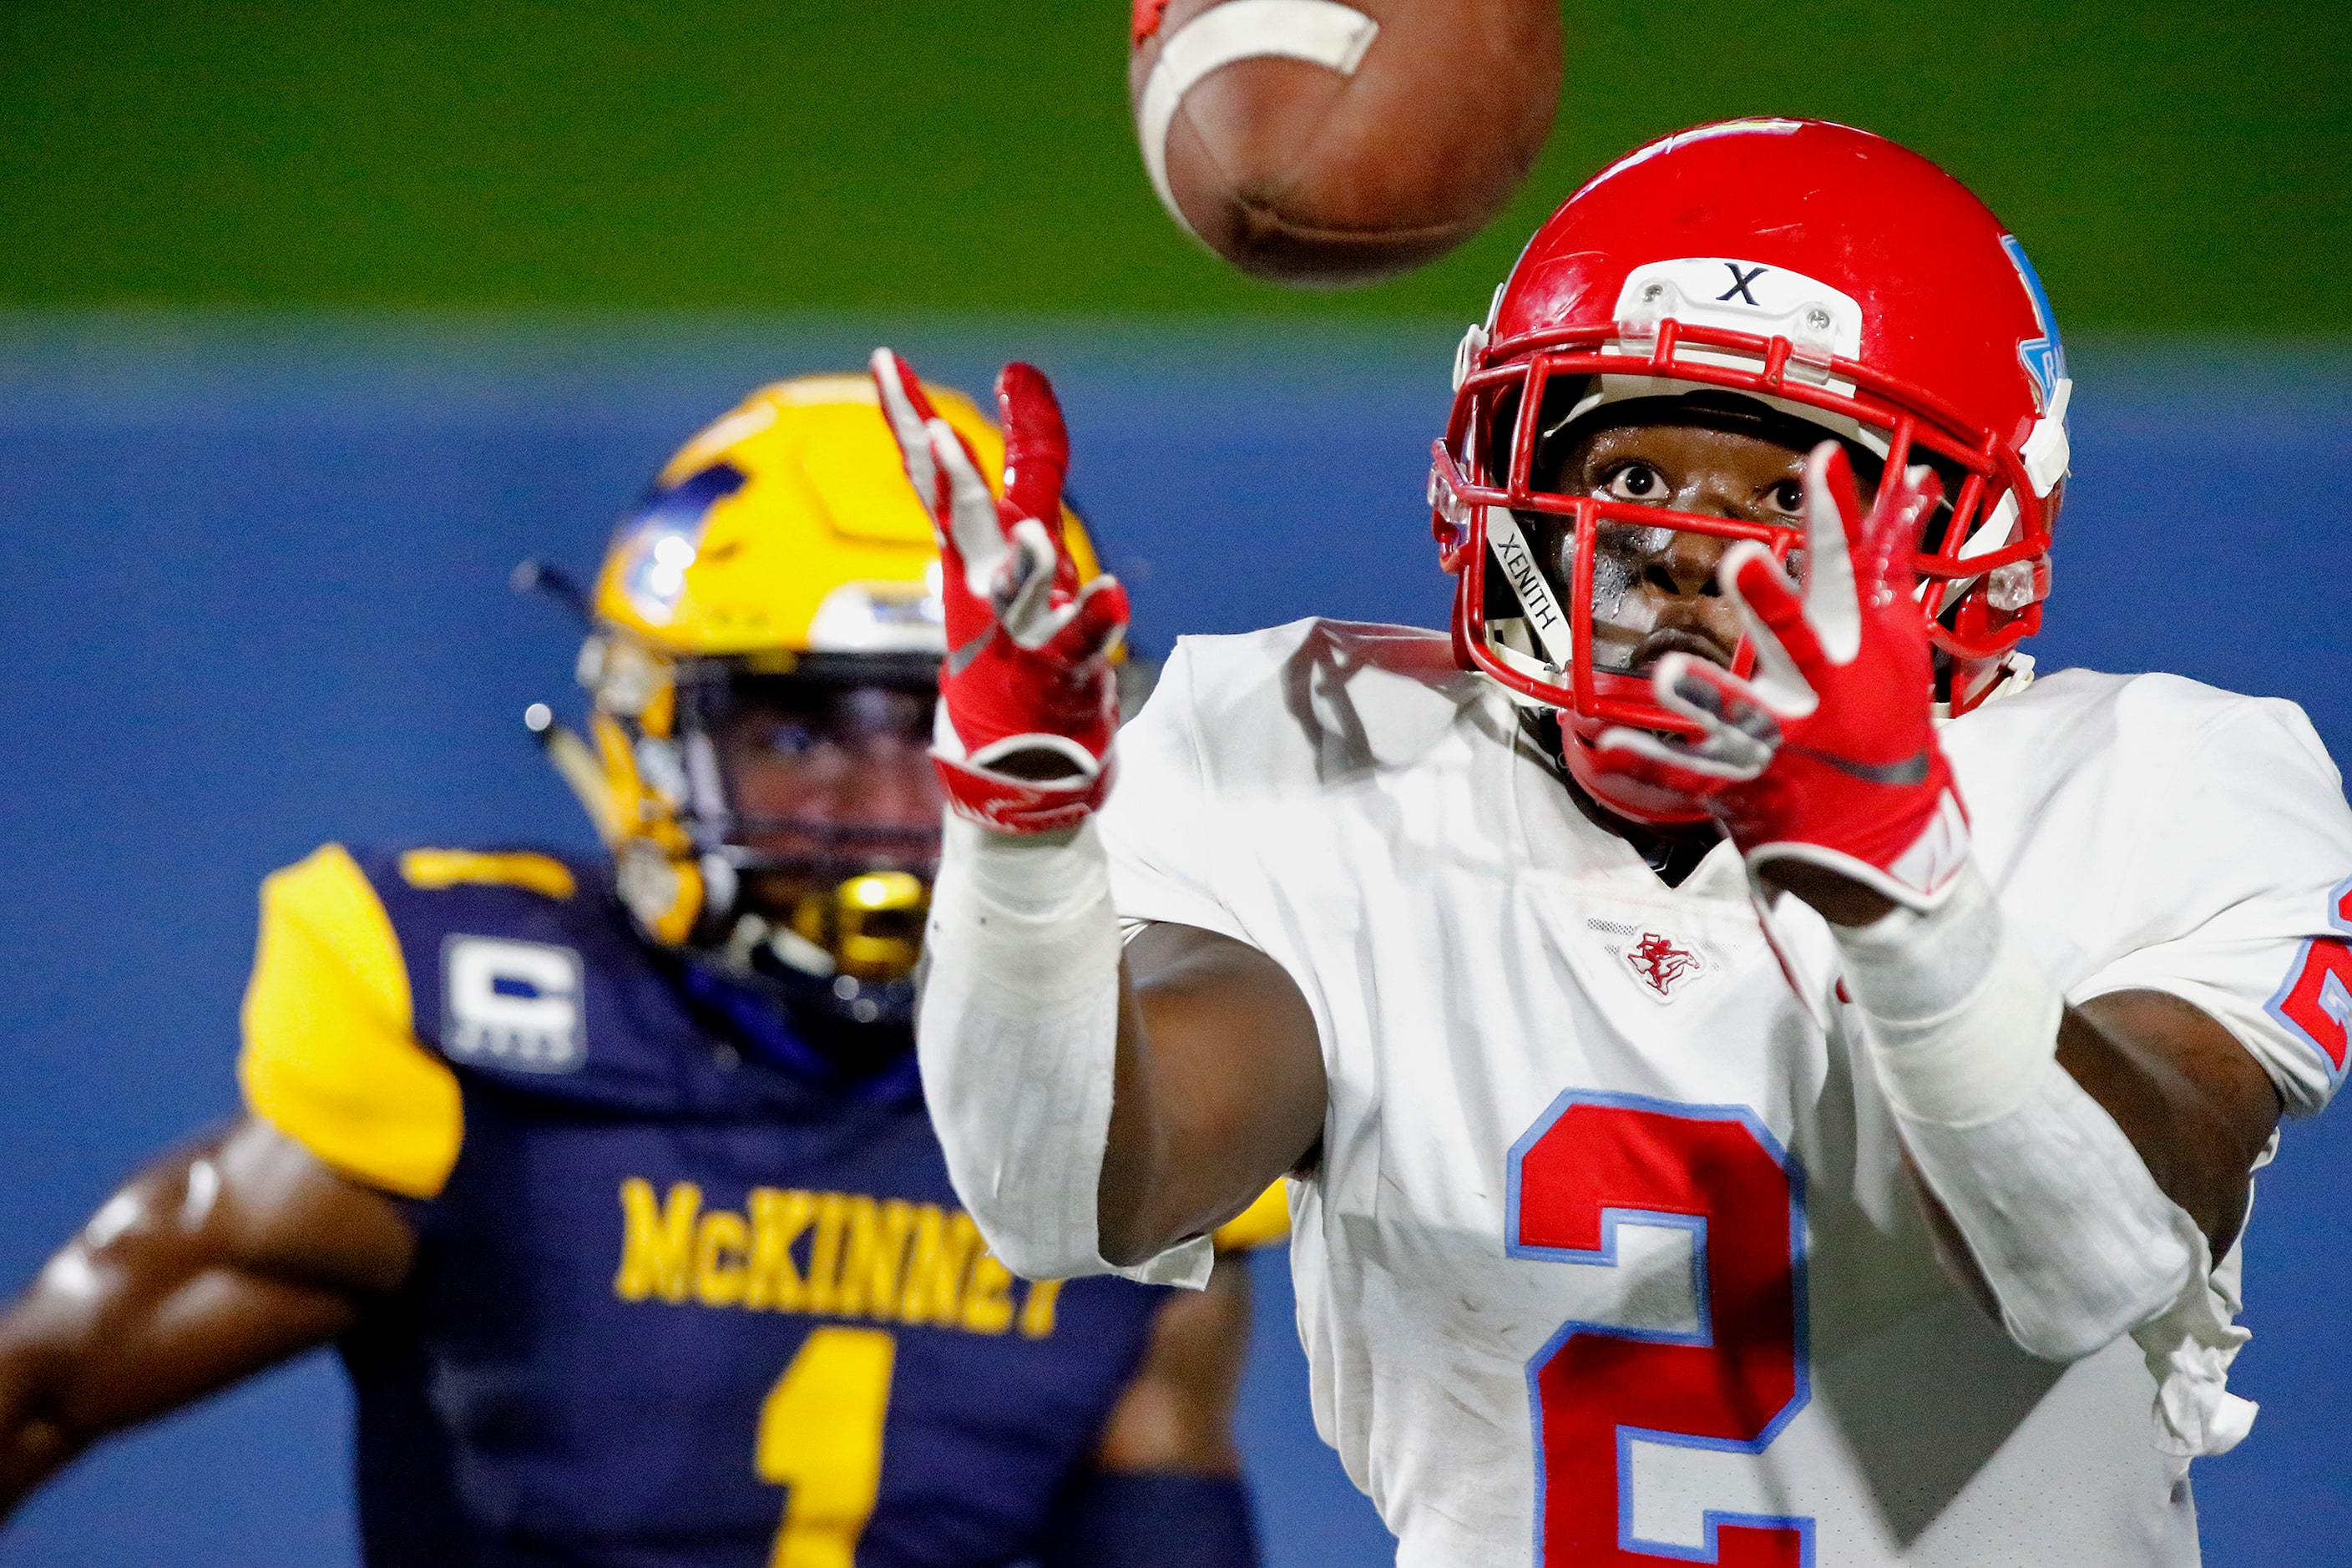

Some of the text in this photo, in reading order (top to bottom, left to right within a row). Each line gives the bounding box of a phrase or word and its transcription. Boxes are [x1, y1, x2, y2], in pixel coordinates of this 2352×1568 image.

[1716, 262, 1769, 306] X
[1498, 532, 1558, 630] XENITH
[451, 942, 576, 1027] C
[1505, 1087, 1816, 1568] 2
[756, 1325, 897, 1568] 1
